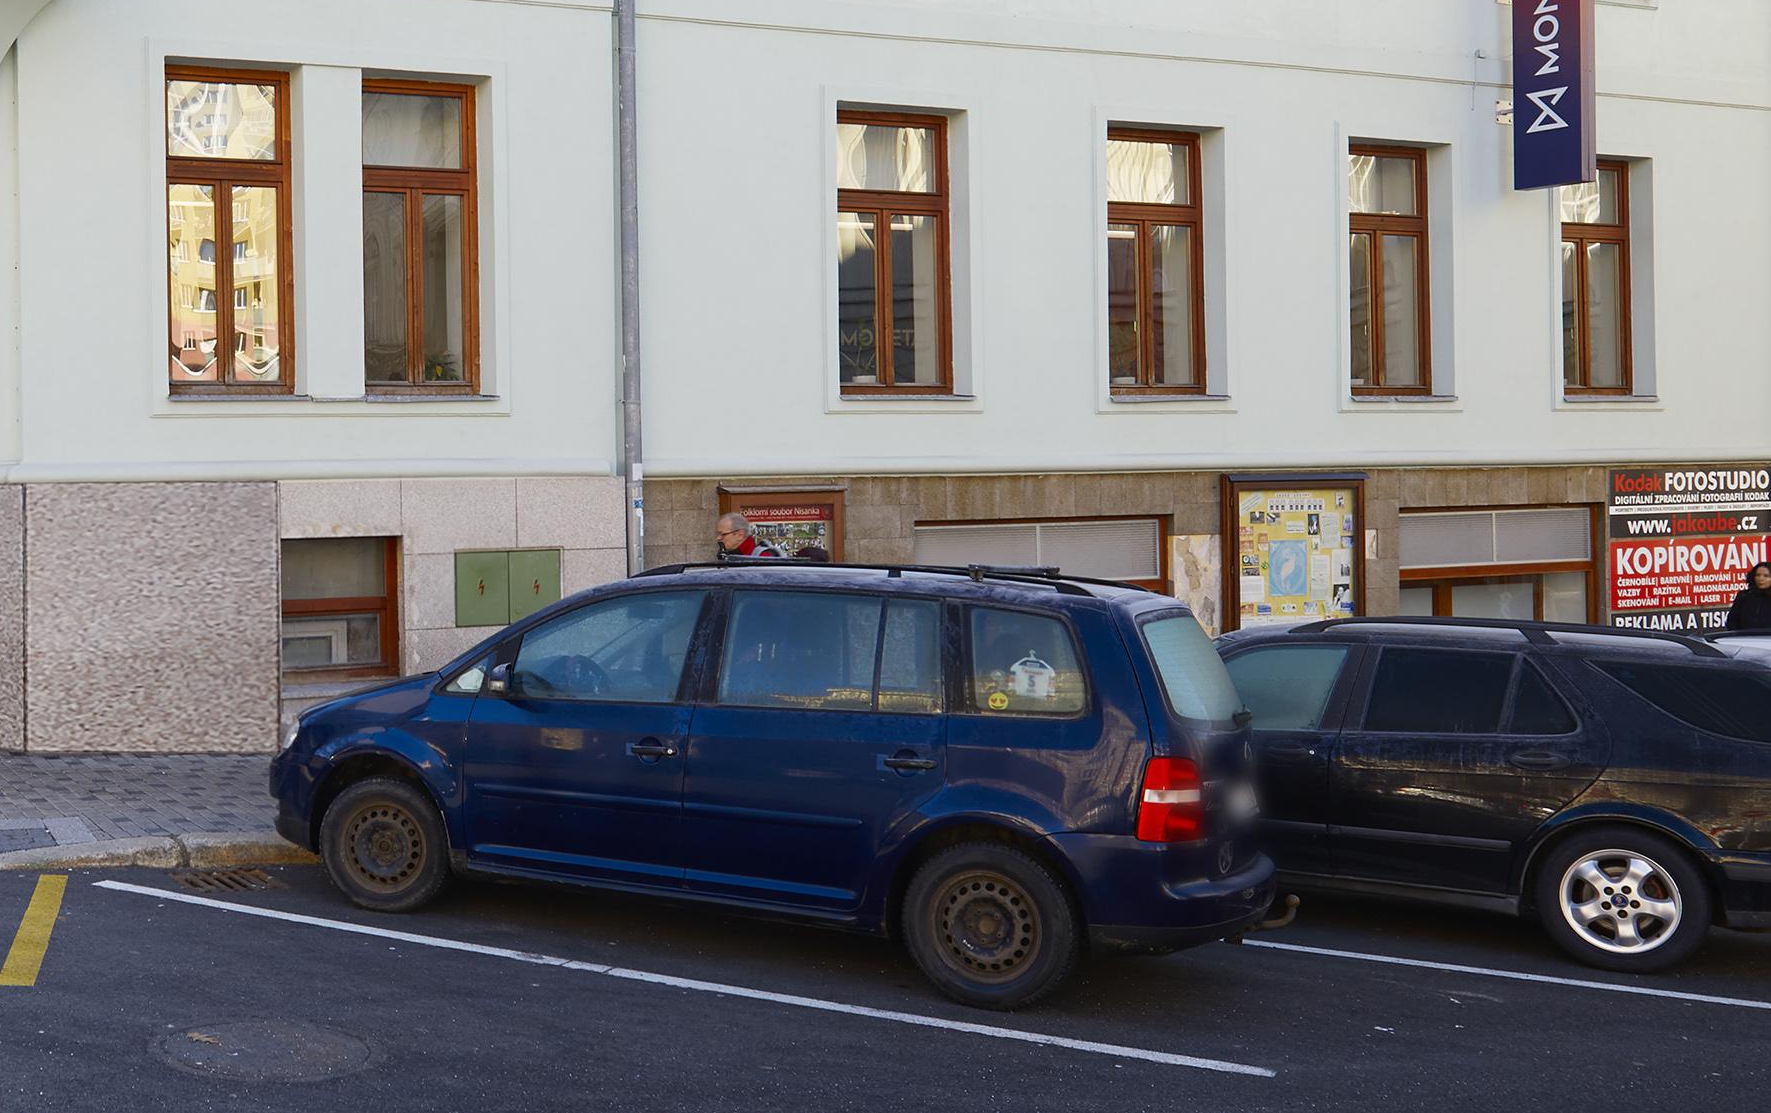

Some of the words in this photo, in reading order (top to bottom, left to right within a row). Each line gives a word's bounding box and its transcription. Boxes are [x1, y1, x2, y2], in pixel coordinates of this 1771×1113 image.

[1614, 473, 1662, 492] Kodak
[1665, 470, 1769, 491] FOTOSTUDIO
[1615, 492, 1653, 505] DIGITÁLNÍ
[1654, 492, 1700, 504] ZPRACOVÁNÍ
[1701, 490, 1744, 502] FOTOGRAFIÍ
[1744, 492, 1769, 501] KODAK
[770, 507, 793, 515] soubor
[1627, 512, 1758, 536] www.jakoube.cz
[1616, 535, 1767, 575] KOPÍROVÁNÍ
[1694, 571, 1731, 583] RÁMOVÁNÍ
[1617, 588, 1641, 597] VAZBY
[1653, 585, 1682, 595] RAZÍTKA
[1693, 582, 1748, 593] MALONÁKLADOV
[1617, 596, 1659, 608] SKENOVÁNÍ
[1668, 596, 1691, 605] E-MAIL
[1700, 594, 1721, 603] LASER
[1686, 612, 1698, 629] A
